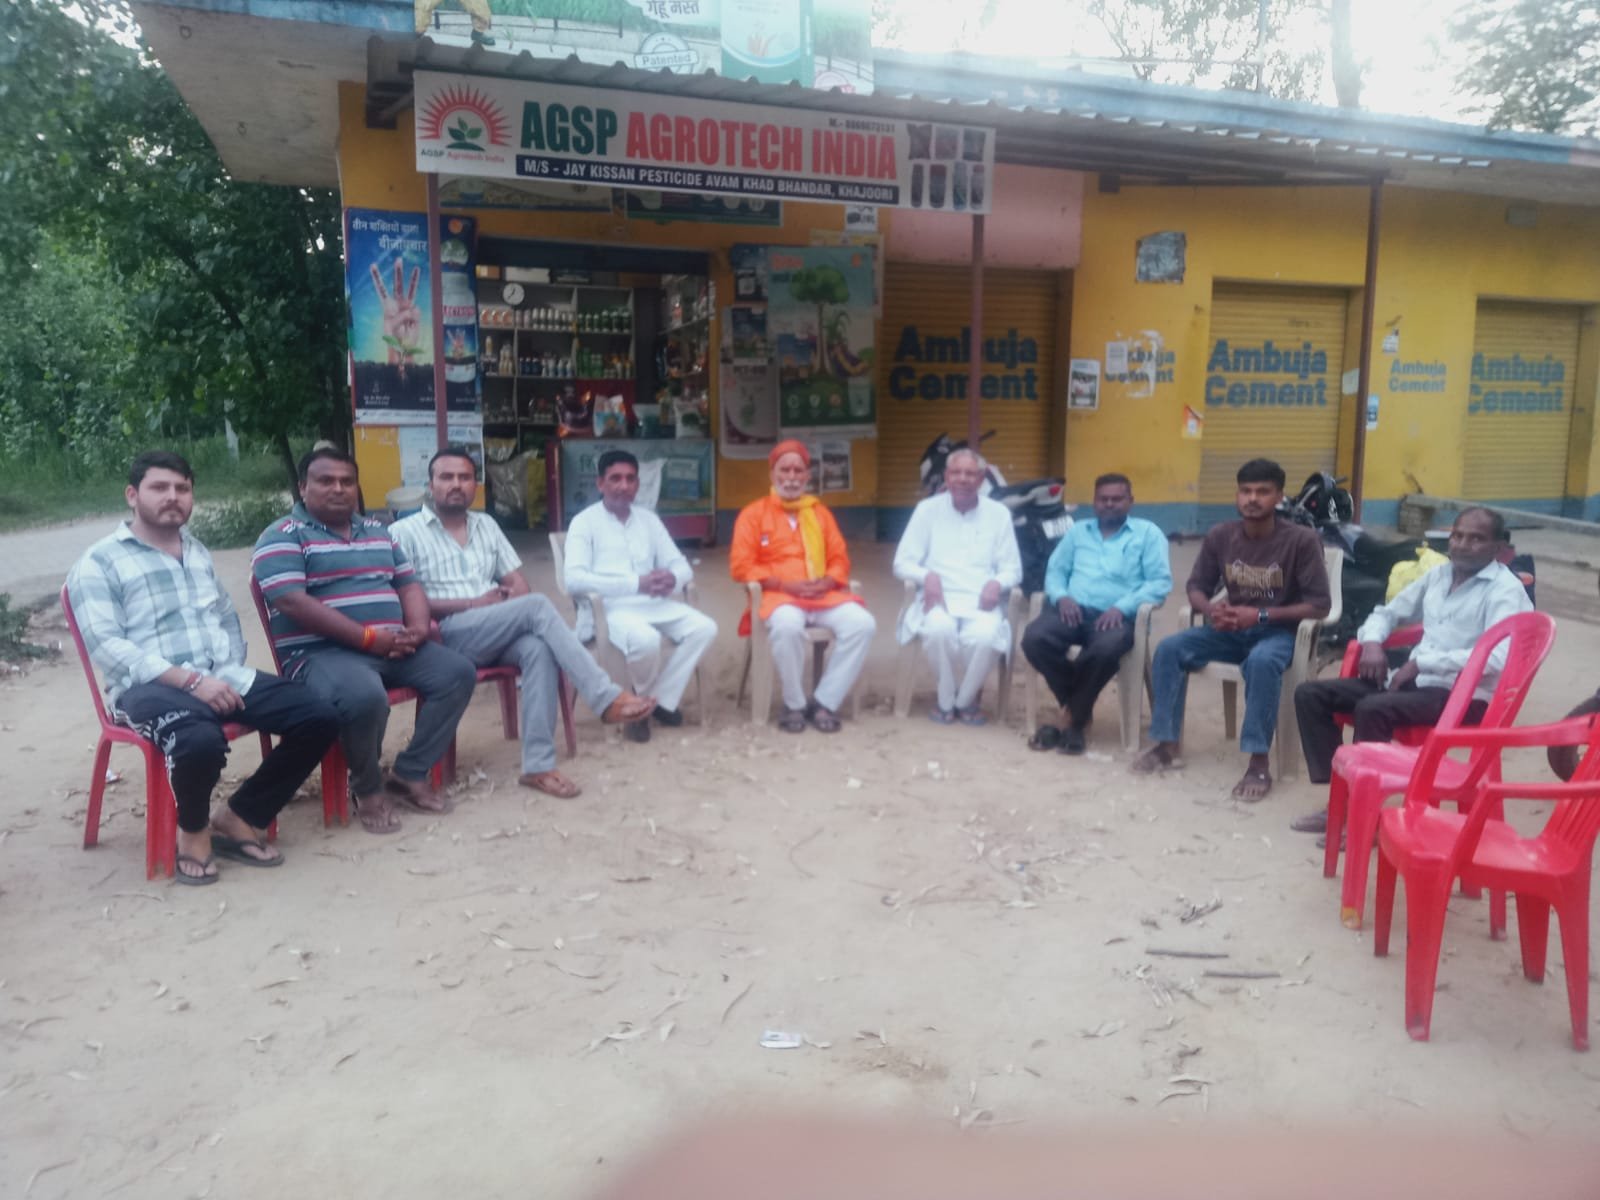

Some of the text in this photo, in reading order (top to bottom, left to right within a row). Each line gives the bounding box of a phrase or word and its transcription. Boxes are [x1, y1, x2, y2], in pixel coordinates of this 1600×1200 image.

[641, 52, 691, 67] Patented
[420, 148, 444, 157] AGSP
[520, 101, 897, 180] AGSP AGROTECH INDIA
[524, 159, 549, 174] M/S
[563, 163, 586, 177] JAY
[590, 165, 635, 181] KISSAN
[639, 169, 702, 186] PESTICIDE
[705, 175, 739, 189] AVAM
[743, 177, 774, 192] KHAD
[777, 182, 836, 199] BHANDAR,
[838, 185, 893, 201] KHAJOORI
[1206, 339, 1328, 379] Ambuja
[1390, 358, 1447, 377] Ambuja
[1471, 352, 1566, 387] Ambuja
[1205, 374, 1328, 406] Cement
[1388, 376, 1446, 392] Cement
